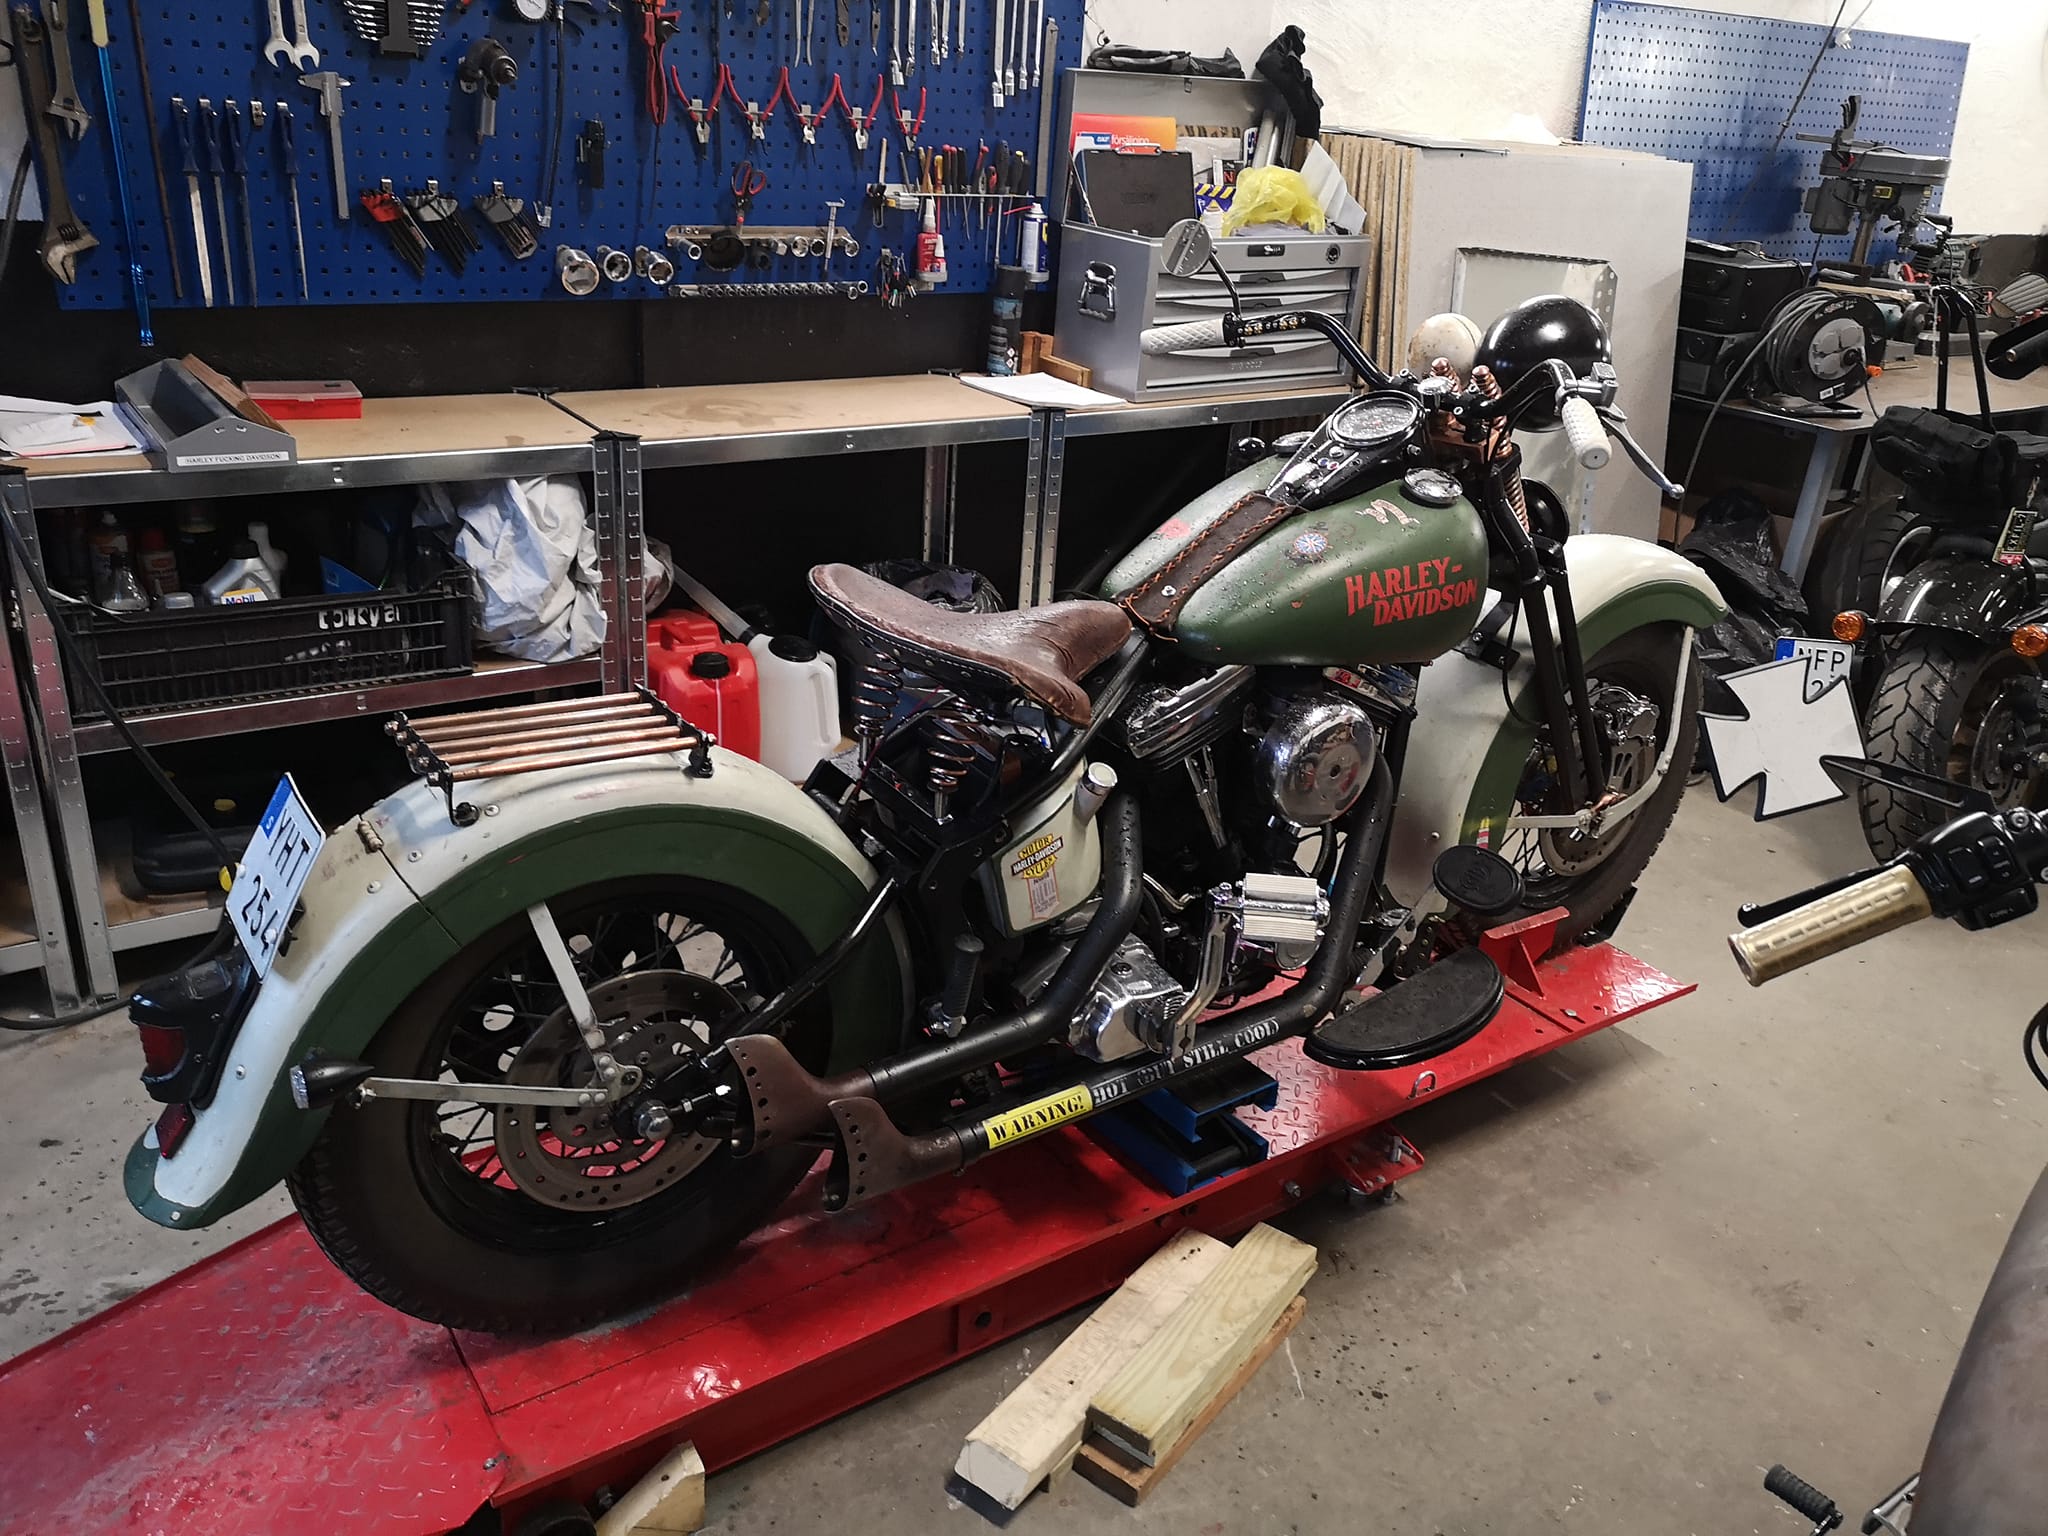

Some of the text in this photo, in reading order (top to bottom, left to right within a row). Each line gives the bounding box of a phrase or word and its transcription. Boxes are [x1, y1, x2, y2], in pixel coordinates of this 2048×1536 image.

[225, 594, 256, 604] Mobil
[1344, 556, 1463, 617] HARLEY-
[1373, 577, 1478, 627] DAVIDSON
[268, 808, 311, 888] YHT
[1012, 840, 1061, 874] HARLEY-DAVIDSON
[1020, 836, 1051, 858] MOTOR
[1025, 856, 1054, 877] CYCLES
[992, 1094, 1085, 1142] WARNING!
[1182, 1038, 1229, 1068] STILL
[1233, 1017, 1280, 1048] COOL)
